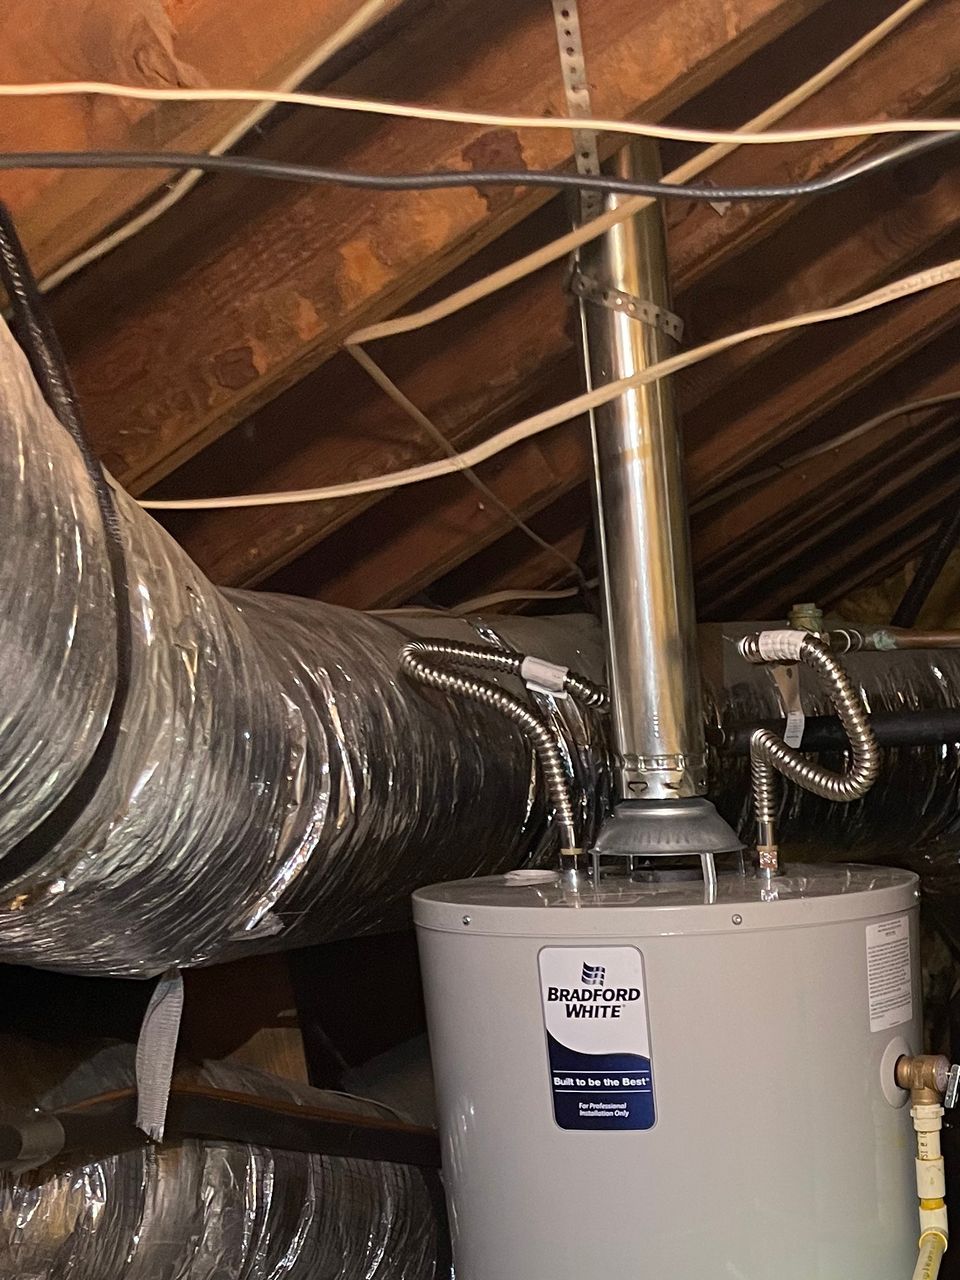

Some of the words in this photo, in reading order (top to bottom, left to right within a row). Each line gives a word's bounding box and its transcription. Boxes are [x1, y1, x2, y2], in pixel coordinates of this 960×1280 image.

[547, 986, 641, 1002] BRADFORD
[565, 1003, 622, 1018] WHITE
[553, 1077, 574, 1086] Built
[576, 1078, 586, 1086] to
[588, 1078, 601, 1086] be
[603, 1078, 620, 1086] the
